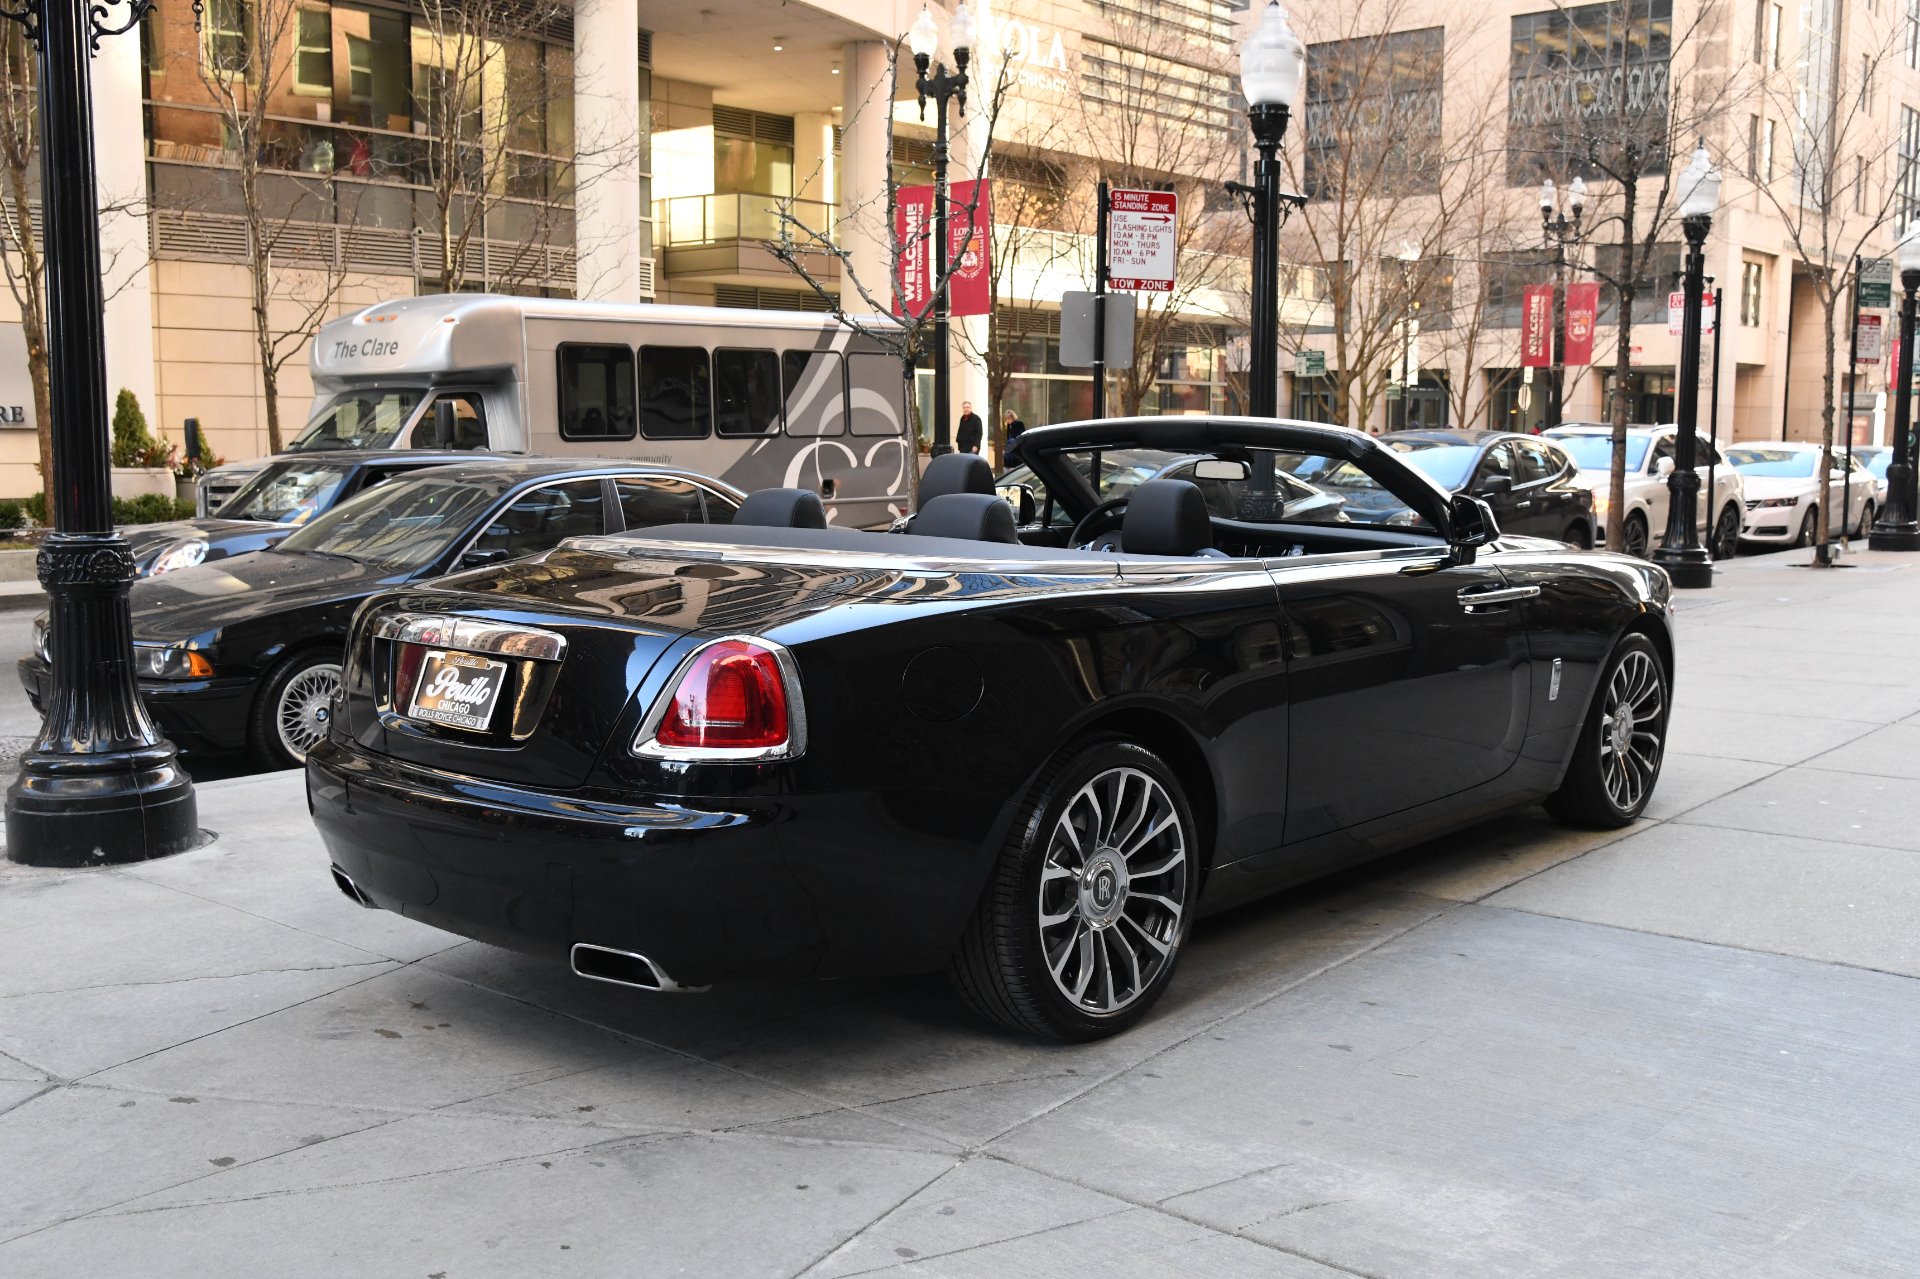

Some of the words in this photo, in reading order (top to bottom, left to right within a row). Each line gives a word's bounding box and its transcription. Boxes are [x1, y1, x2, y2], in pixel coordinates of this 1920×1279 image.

[1019, 70, 1069, 93] CHICAGO
[1114, 192, 1121, 201] 15
[1124, 193, 1150, 202] MINUTE
[1114, 201, 1148, 211] STANDING
[1151, 203, 1170, 212] ZONE
[1113, 214, 1128, 223] USE
[953, 226, 984, 237] LOYLA
[1113, 223, 1148, 233] FLASHING
[1148, 225, 1173, 234] LIGHTS
[1146, 233, 1158, 241] PM
[1113, 240, 1129, 248] MON
[1137, 241, 1161, 250] THURS
[904, 203, 918, 302] WELCOME
[1112, 256, 1125, 264] FRI
[1131, 257, 1146, 265] SUN
[1112, 278, 1135, 289] TOW
[1140, 280, 1169, 290] ZONE
[334, 340, 358, 359] The
[361, 337, 399, 357] Clare
[625, 452, 673, 465] community
[451, 655, 479, 666] Perillo
[426, 667, 491, 705] Perillo
[438, 699, 470, 714] CHICAGO
[418, 708, 434, 719] ROLLS
[434, 711, 453, 722] ROYCE
[452, 714, 476, 726] CHICAGO
